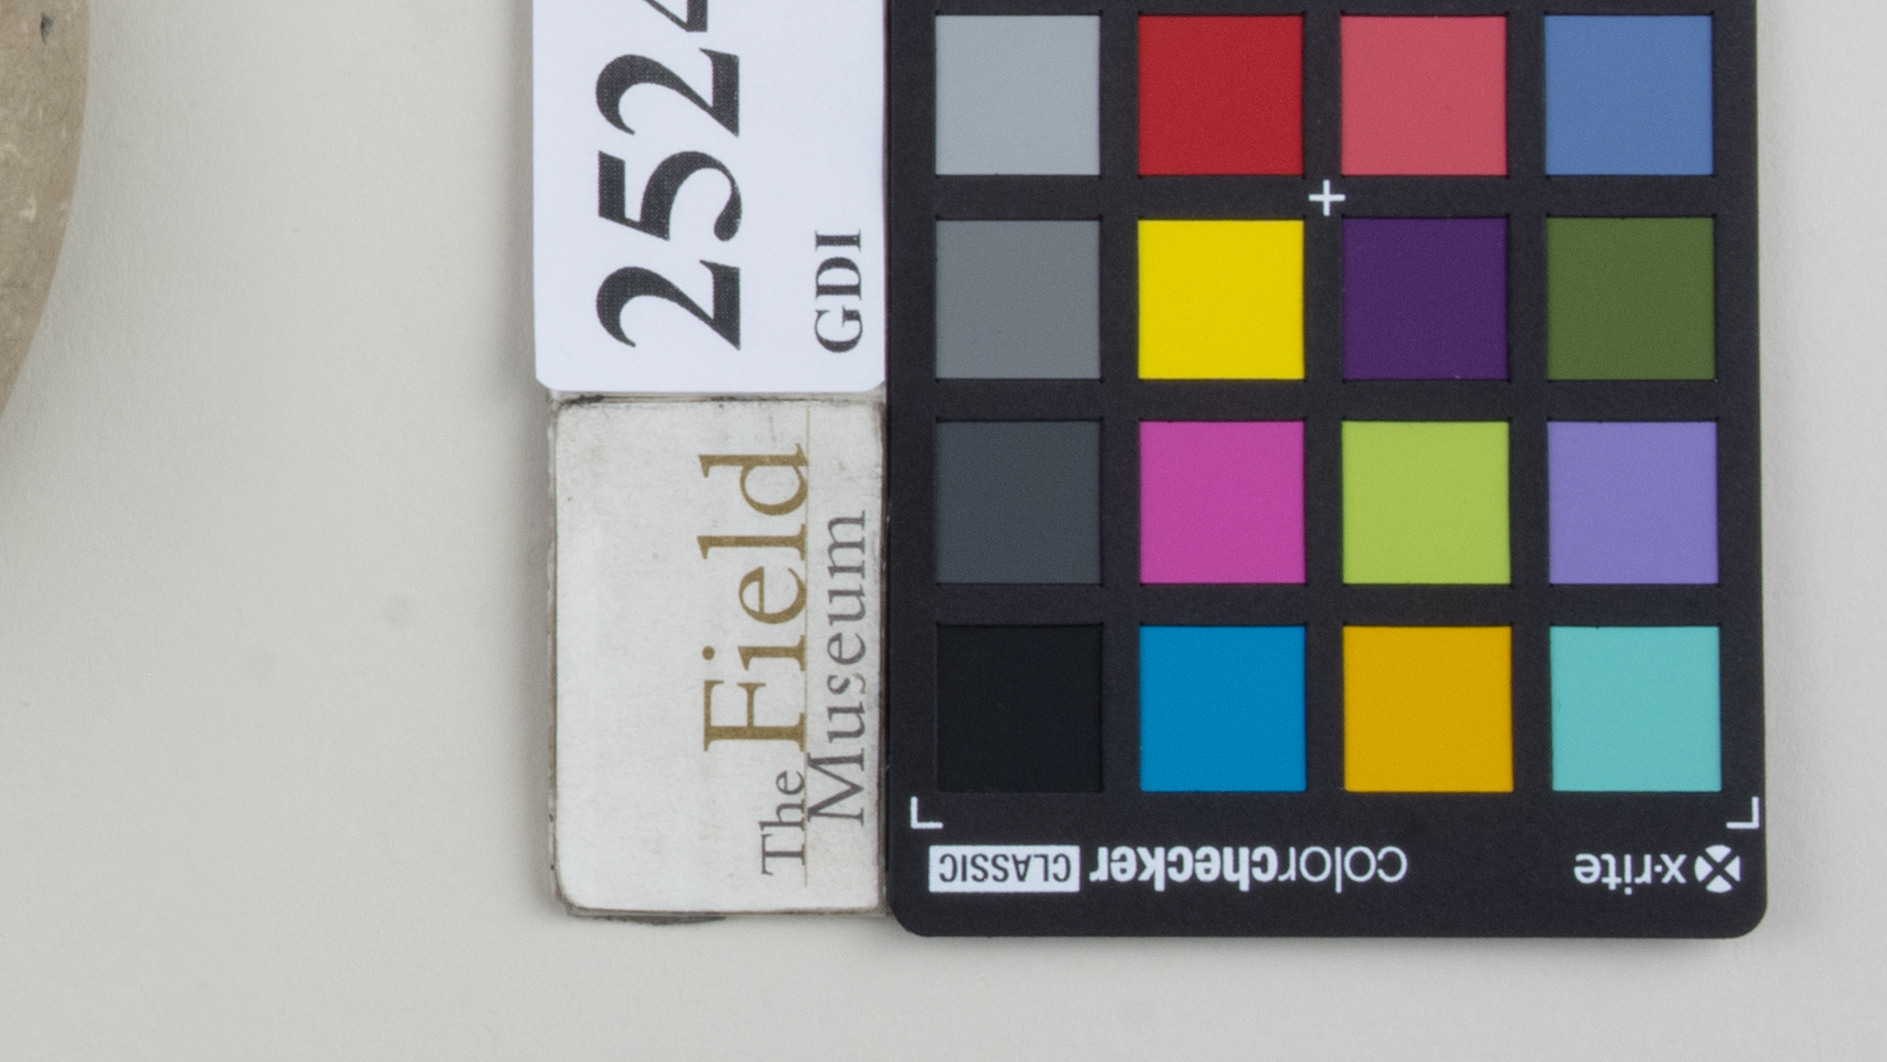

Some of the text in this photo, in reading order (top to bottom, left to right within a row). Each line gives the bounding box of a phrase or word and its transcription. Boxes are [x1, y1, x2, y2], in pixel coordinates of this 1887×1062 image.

[814, 228, 864, 354] GDI
[697, 442, 810, 876] The Field
[807, 509, 867, 827] Museum
[939, 846, 1408, 893] colorchecker CLASSIC
